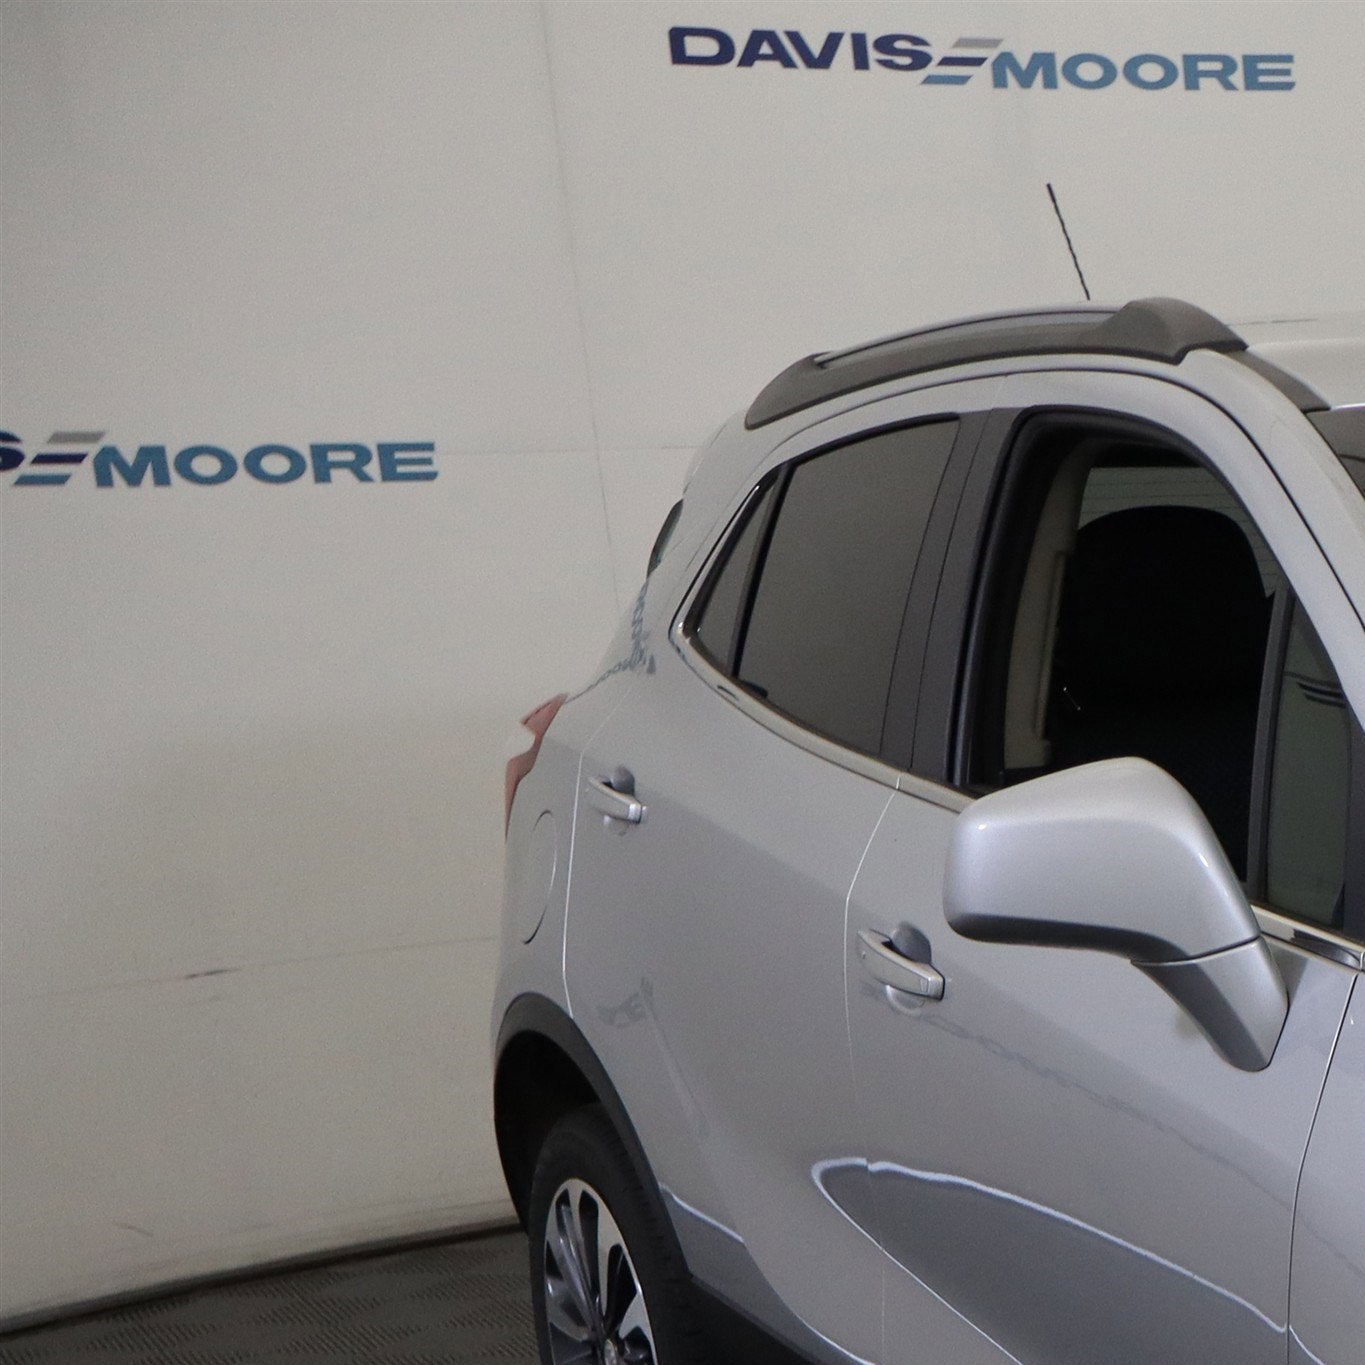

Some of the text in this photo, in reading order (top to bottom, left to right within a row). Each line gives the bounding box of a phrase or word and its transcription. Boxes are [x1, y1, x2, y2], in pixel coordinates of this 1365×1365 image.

[668, 26, 1296, 91] DAVIS MOORE
[92, 441, 439, 487] MOORE
